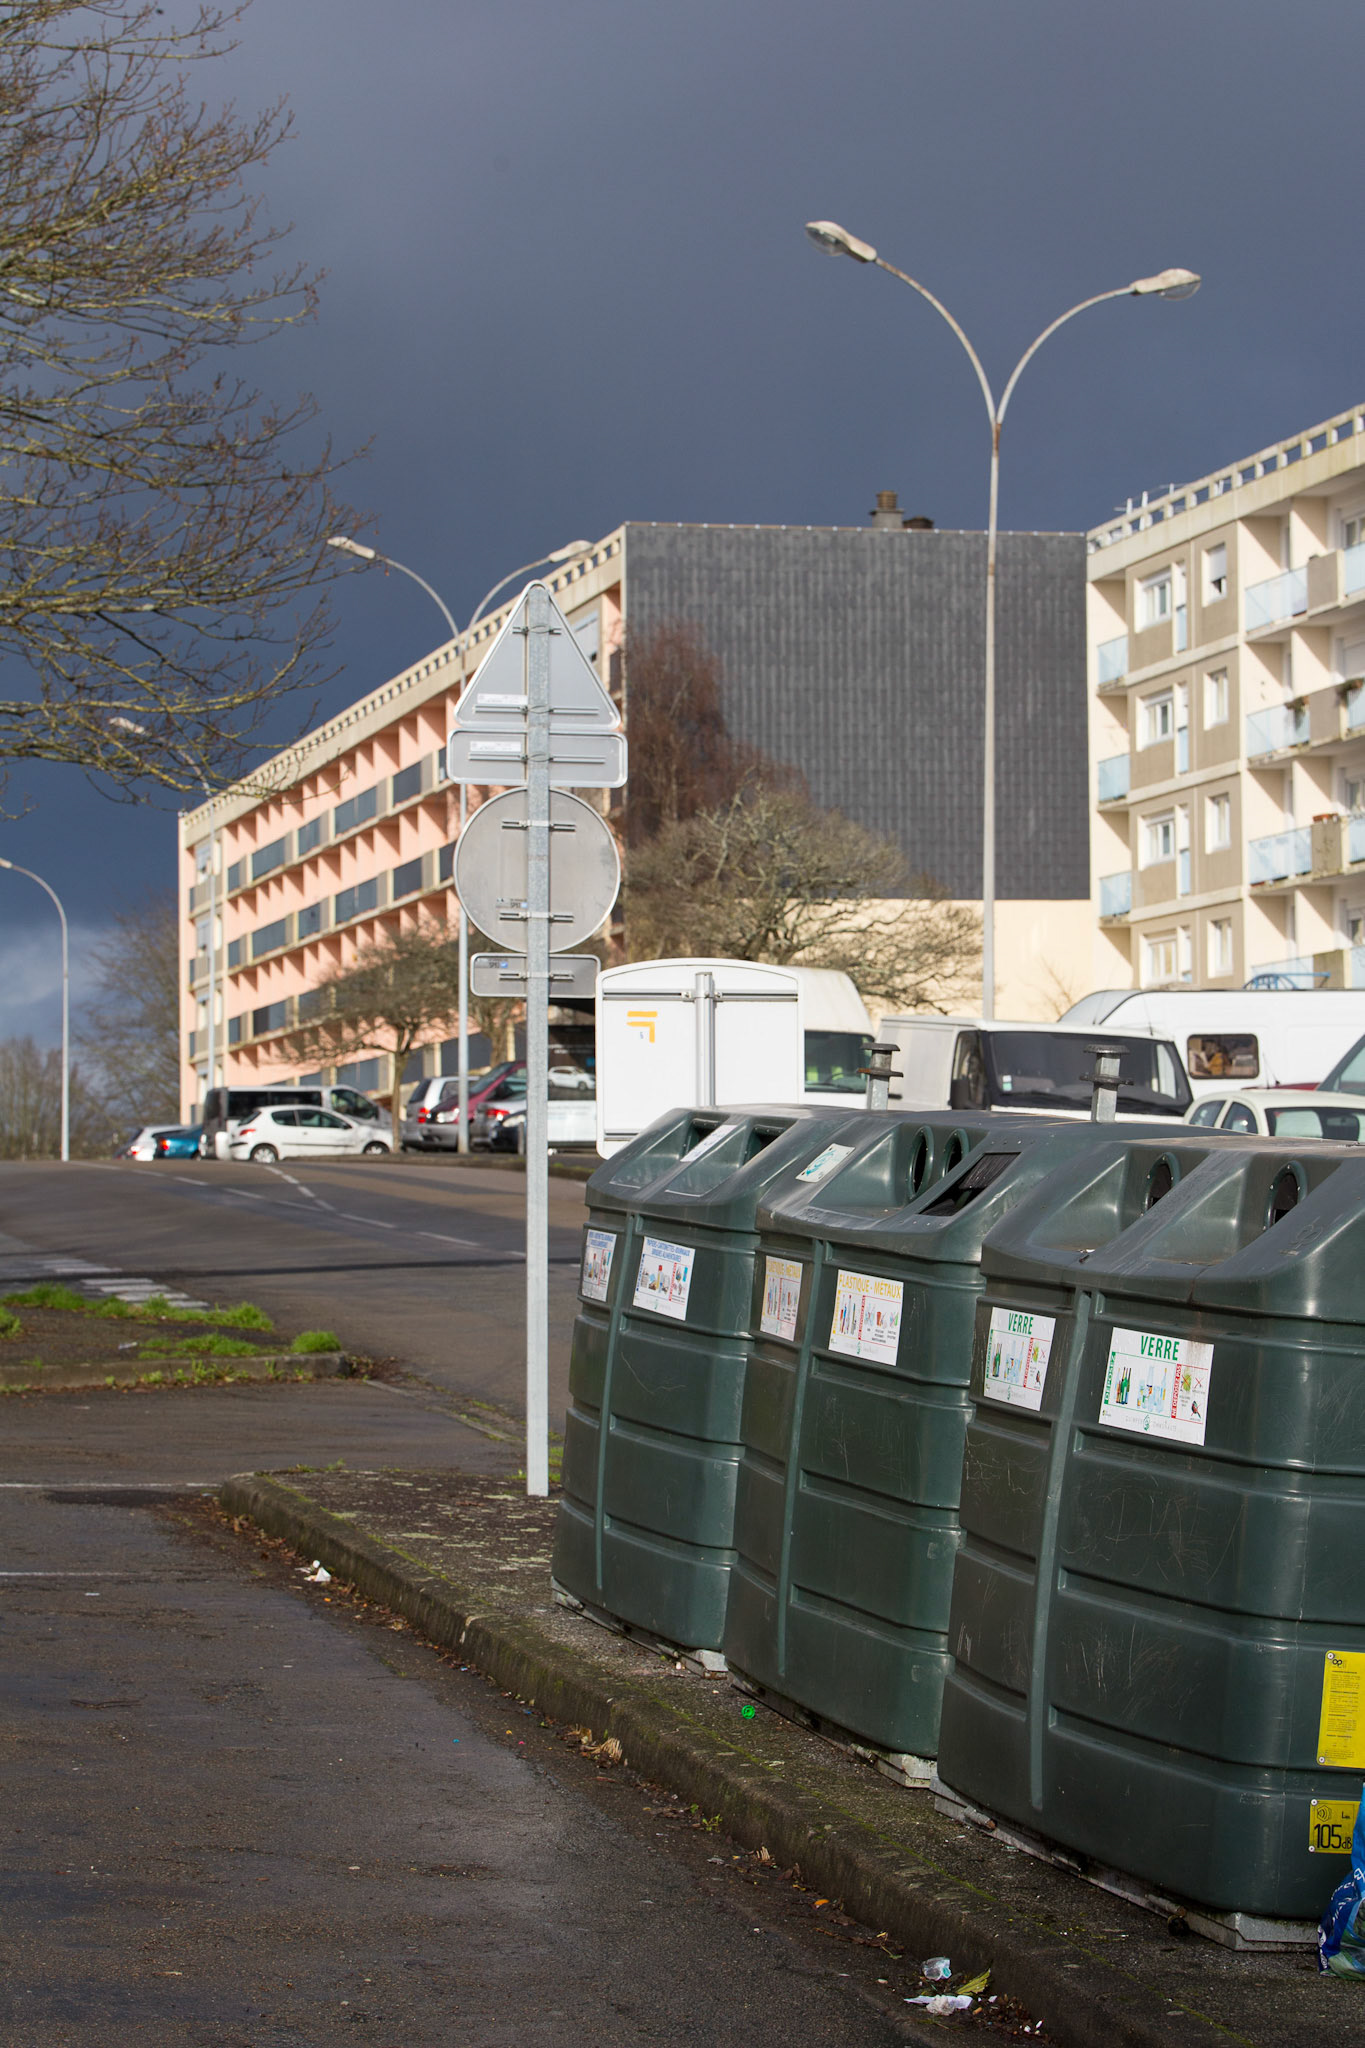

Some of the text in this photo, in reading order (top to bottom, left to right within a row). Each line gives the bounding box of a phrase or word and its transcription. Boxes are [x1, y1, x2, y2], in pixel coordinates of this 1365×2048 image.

[873, 1280, 902, 1298] MÉTAUX
[1008, 1312, 1034, 1335] VERRE
[1140, 1335, 1180, 1361] VERRE
[1314, 1823, 1342, 1849] 105
